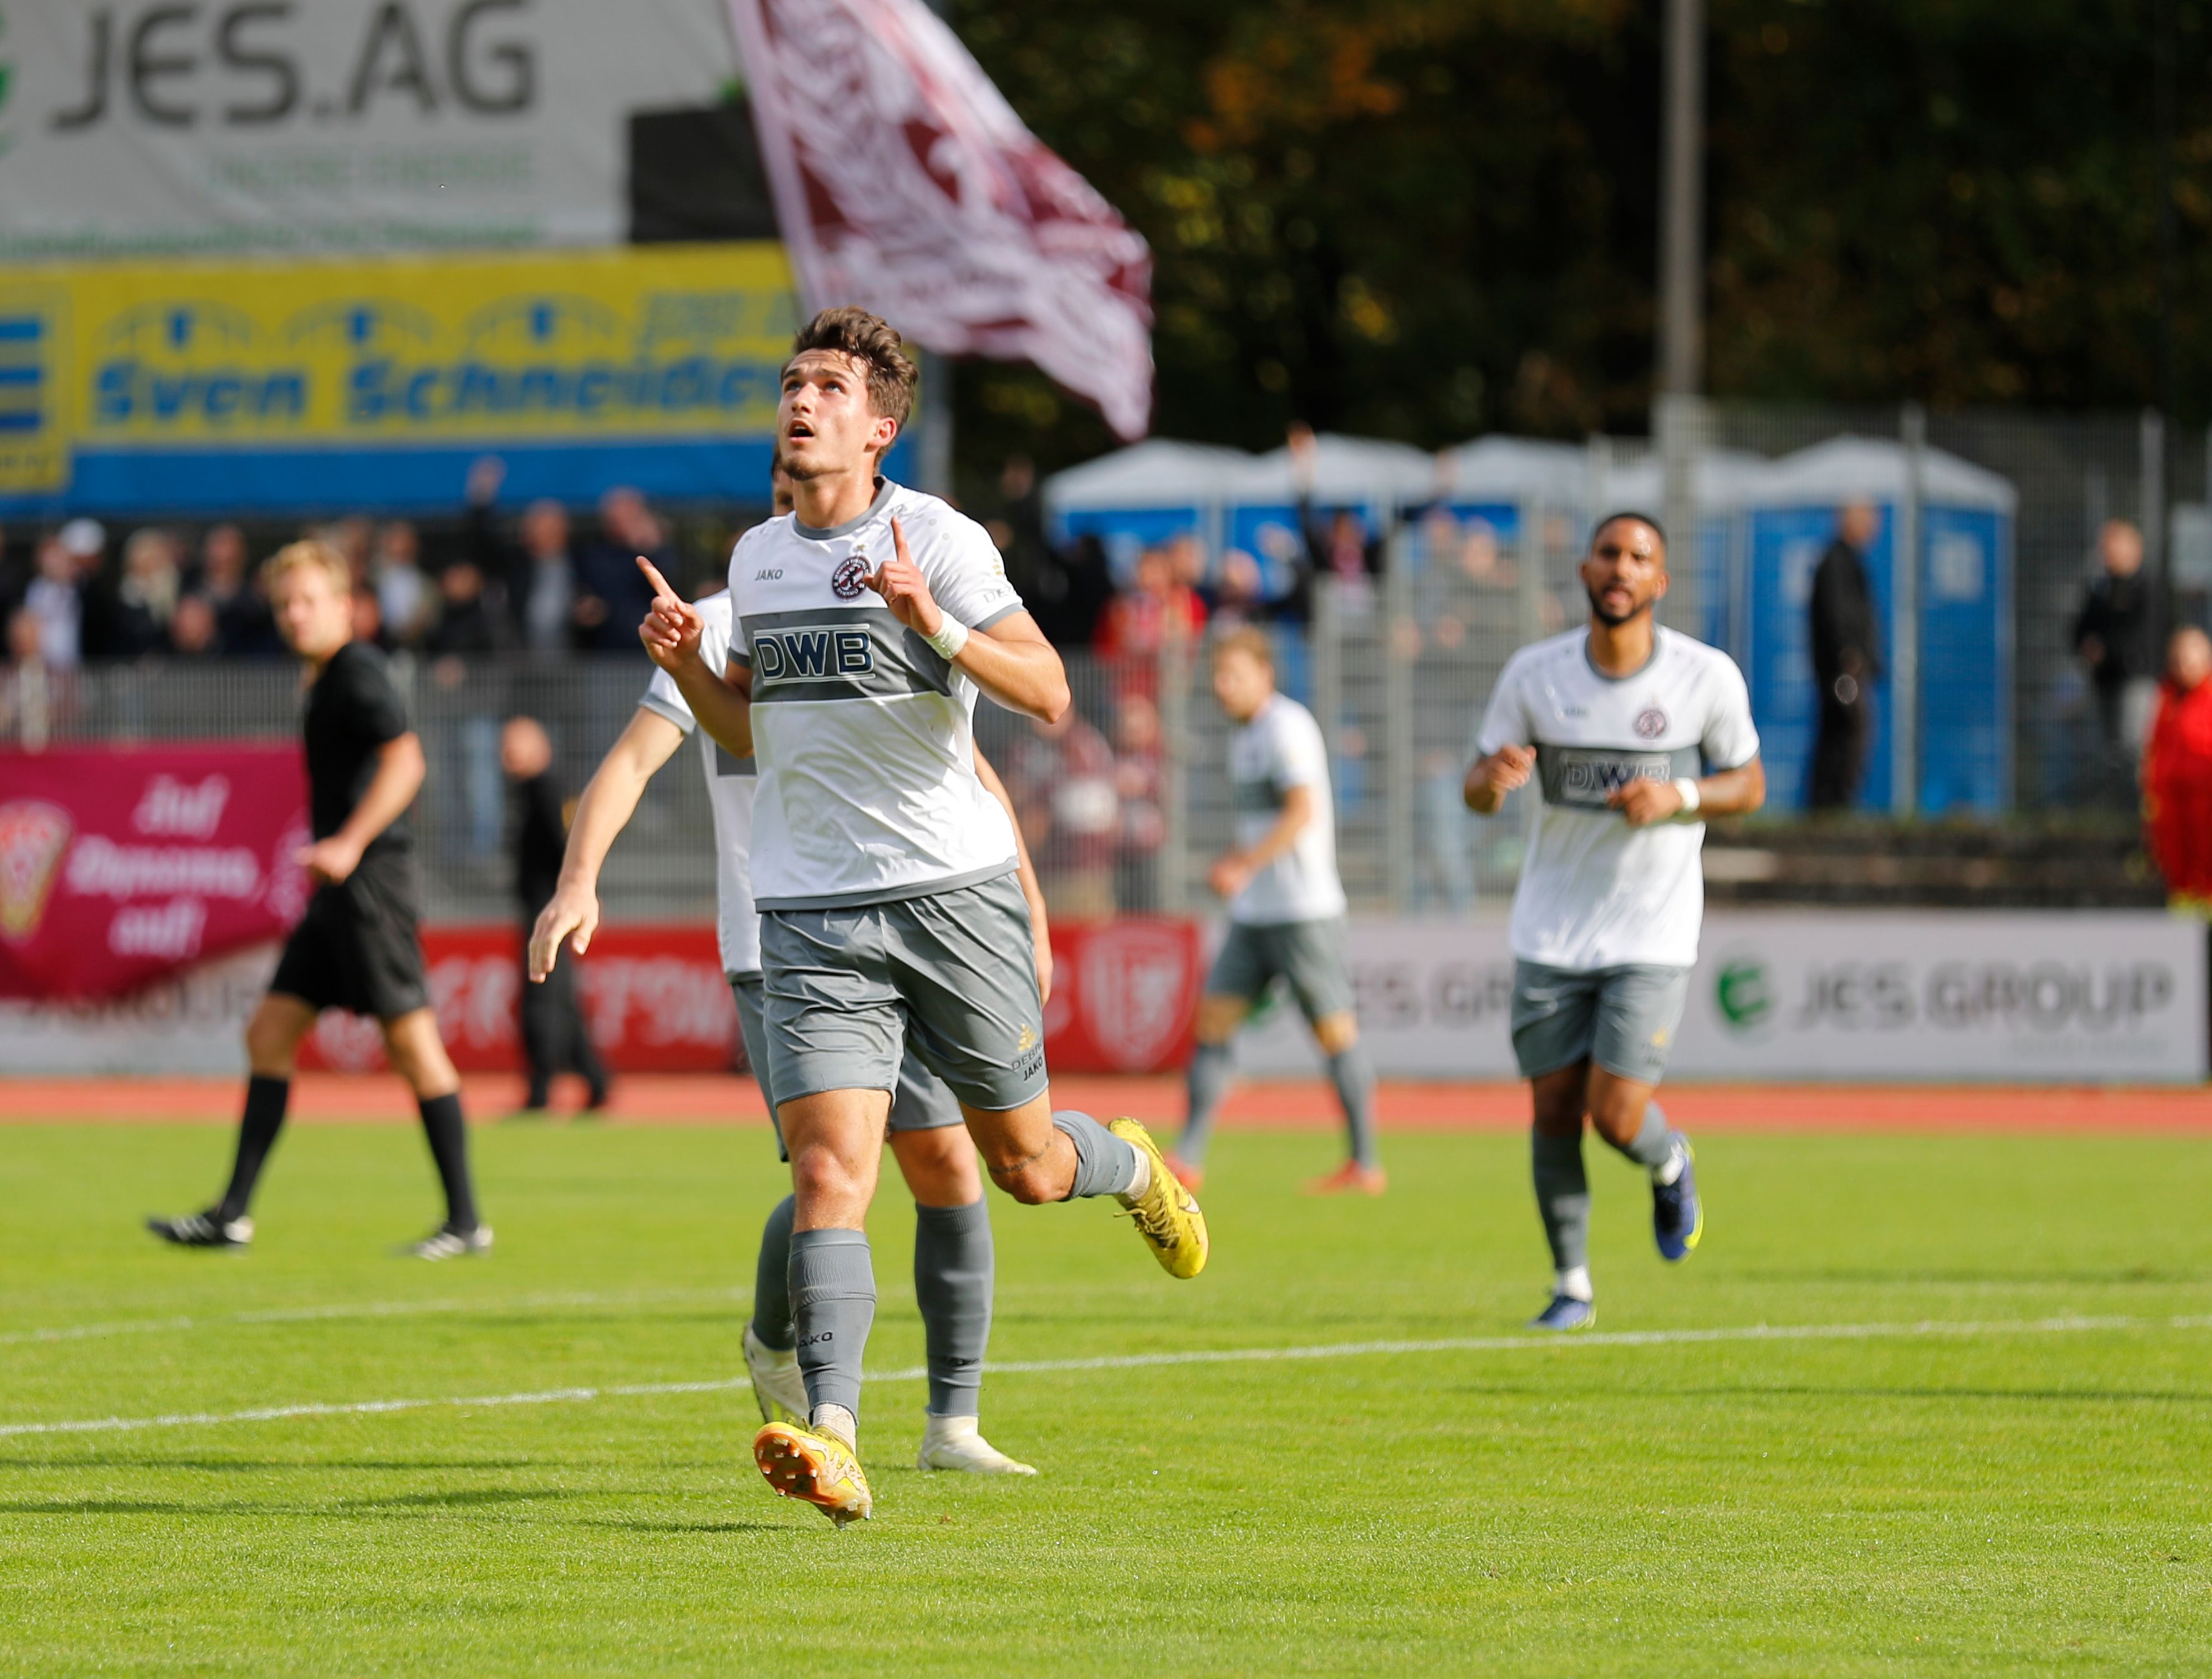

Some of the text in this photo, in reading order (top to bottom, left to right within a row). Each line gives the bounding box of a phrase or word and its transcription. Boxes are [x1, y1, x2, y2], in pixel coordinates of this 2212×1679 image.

[47, 0, 537, 130] JES.AG
[94, 360, 305, 423] Sven
[754, 569, 784, 582] JAKO
[754, 630, 874, 680] DWB
[1024, 1056, 1043, 1082] JAKO
[799, 1332, 834, 1347] AKO
